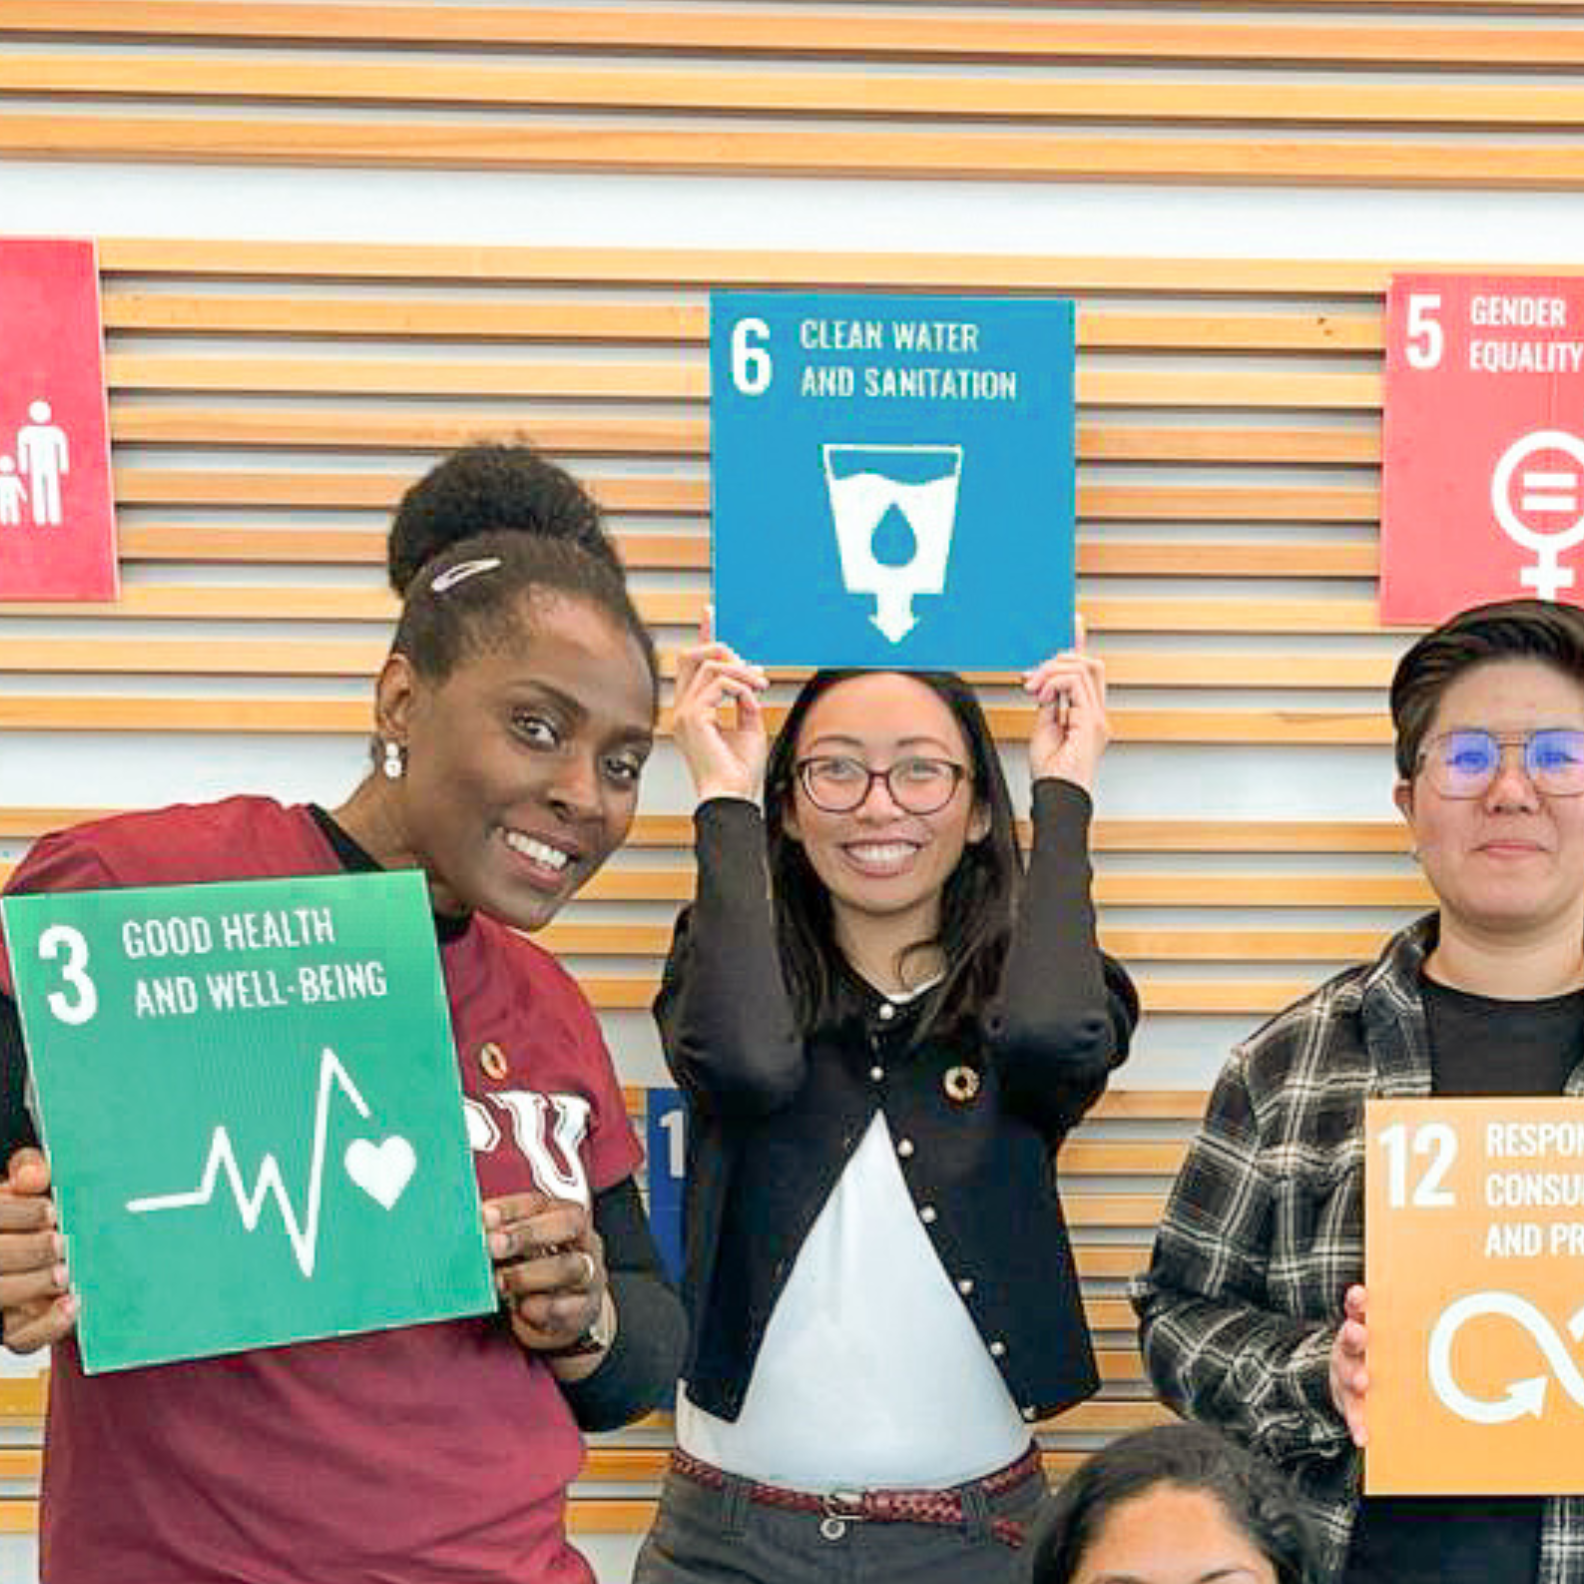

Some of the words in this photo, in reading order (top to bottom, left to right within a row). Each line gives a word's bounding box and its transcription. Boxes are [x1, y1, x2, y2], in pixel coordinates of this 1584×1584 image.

[800, 319, 883, 349] CLEAN
[893, 322, 978, 352] WATER
[1405, 295, 1443, 369] 5
[1470, 295, 1566, 327] GENDER
[732, 318, 771, 395] 6
[802, 366, 854, 396] AND
[865, 367, 1016, 399] SANITATION
[1469, 340, 1584, 373] EQUALITY
[123, 917, 212, 959] GOOD
[221, 907, 335, 950] HEALTH
[39, 924, 97, 1024] 3
[135, 977, 198, 1018] AND
[206, 961, 386, 1010] WELL-BEING
[1377, 1122, 1457, 1208] 12
[1485, 1223, 1543, 1257] AND
